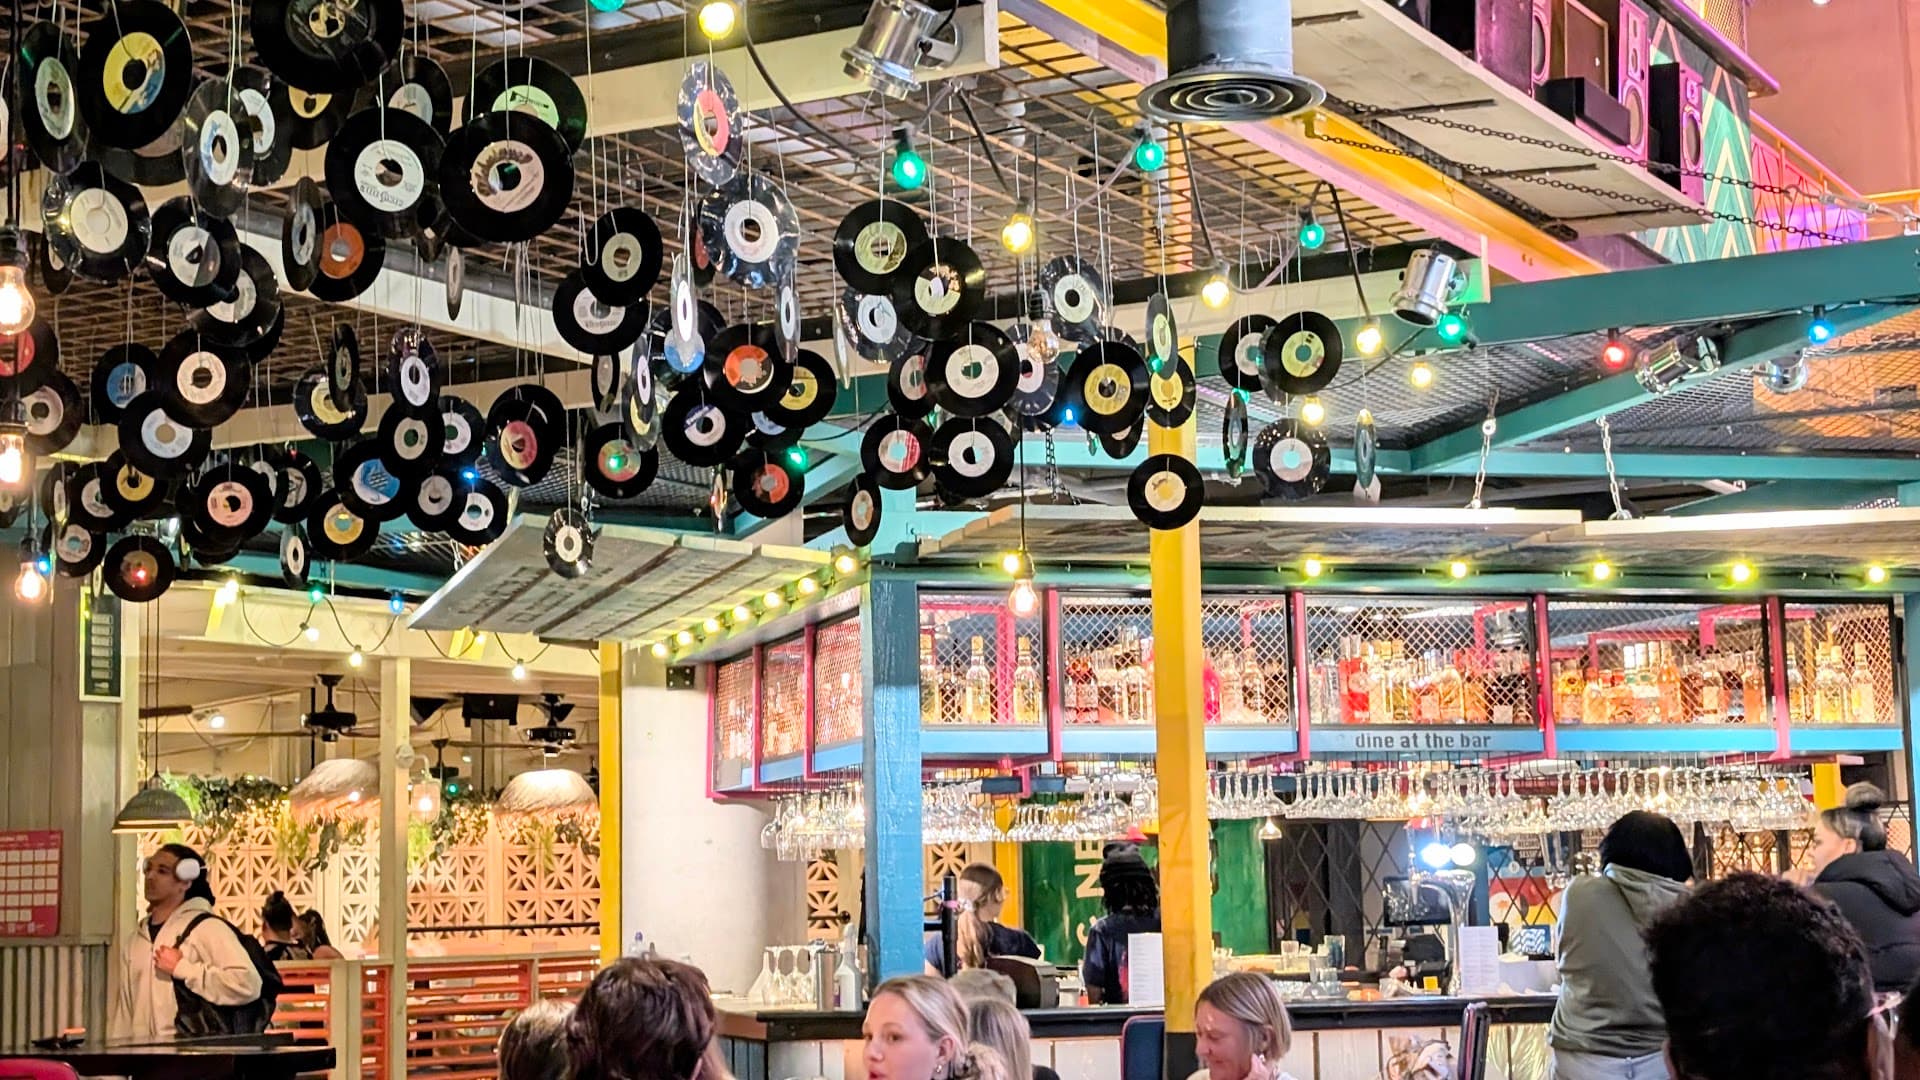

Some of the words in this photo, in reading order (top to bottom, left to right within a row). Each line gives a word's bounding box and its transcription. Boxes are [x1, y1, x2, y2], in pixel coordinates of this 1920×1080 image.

[1355, 732, 1394, 748] dine
[1400, 732, 1419, 748] at
[1425, 732, 1455, 748] the
[1460, 733, 1492, 748] bar
